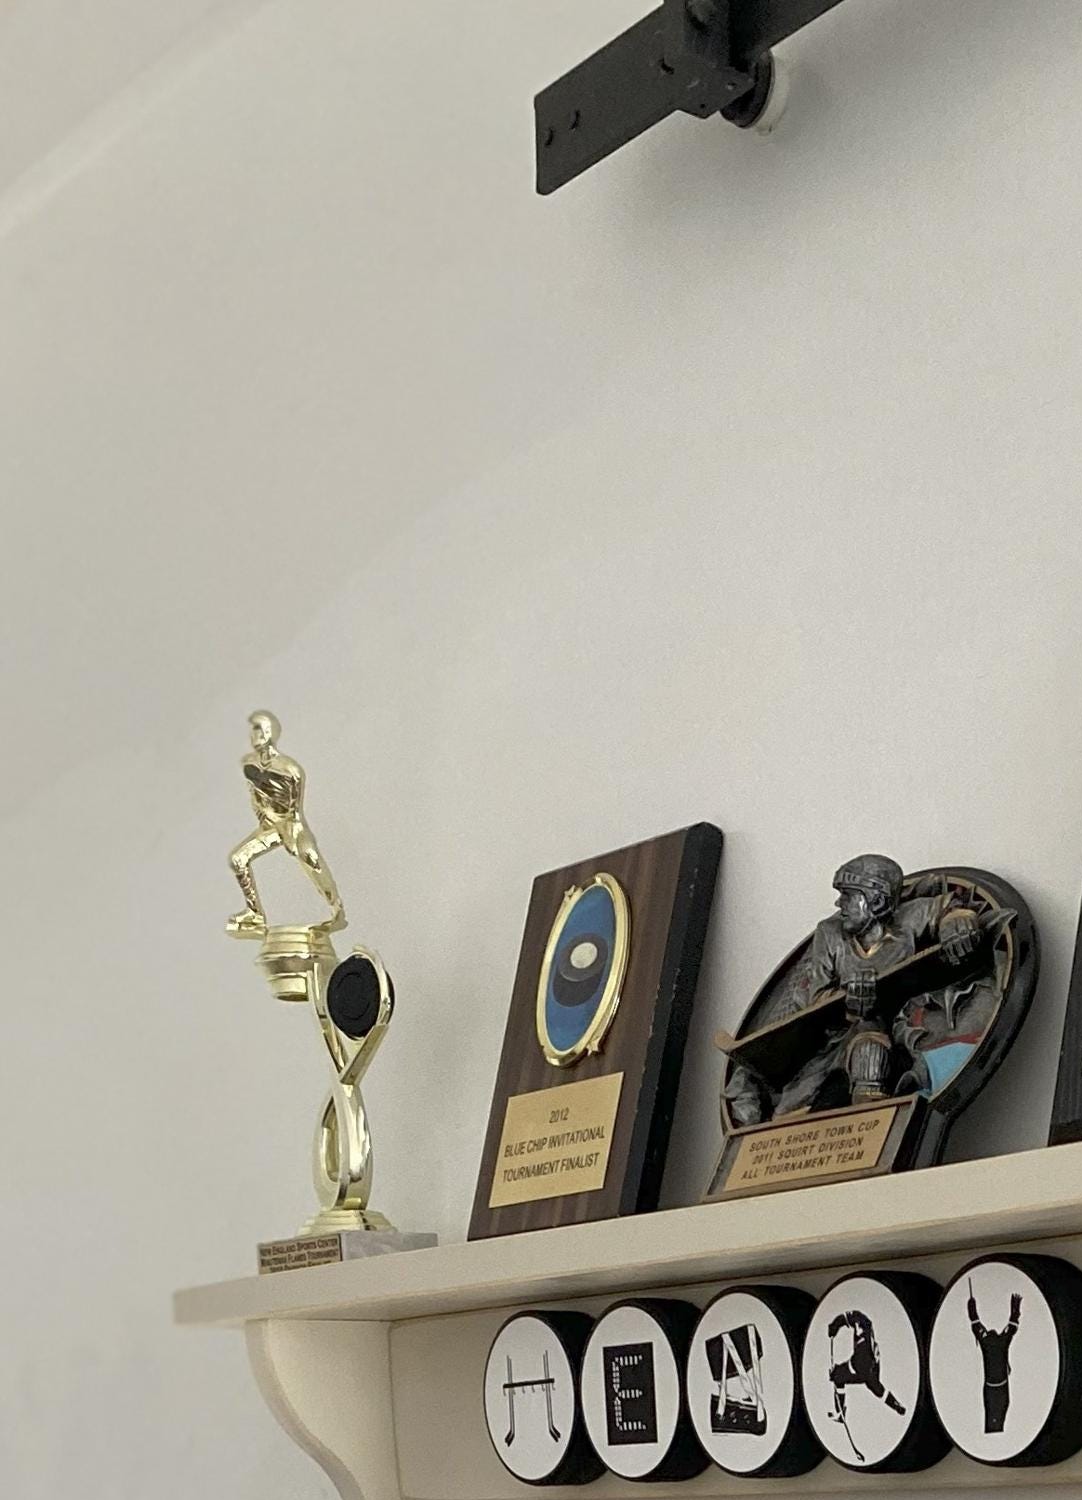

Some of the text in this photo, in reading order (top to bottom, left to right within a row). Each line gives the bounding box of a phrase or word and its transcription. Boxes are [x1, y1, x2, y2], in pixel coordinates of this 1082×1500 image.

[549, 1107, 569, 1123] 2012
[504, 1125, 605, 1158] BLUE CHIP INVITATIONAL
[749, 1119, 881, 1152] SOUTH SHORE TOWN CUP
[777, 1144, 815, 1160] SQUIRT
[818, 1136, 863, 1153] DIVISION
[503, 1152, 600, 1183] TOURNAMENT FINALIST
[740, 1150, 865, 1181] ALL TOURNAMENT TEAM
